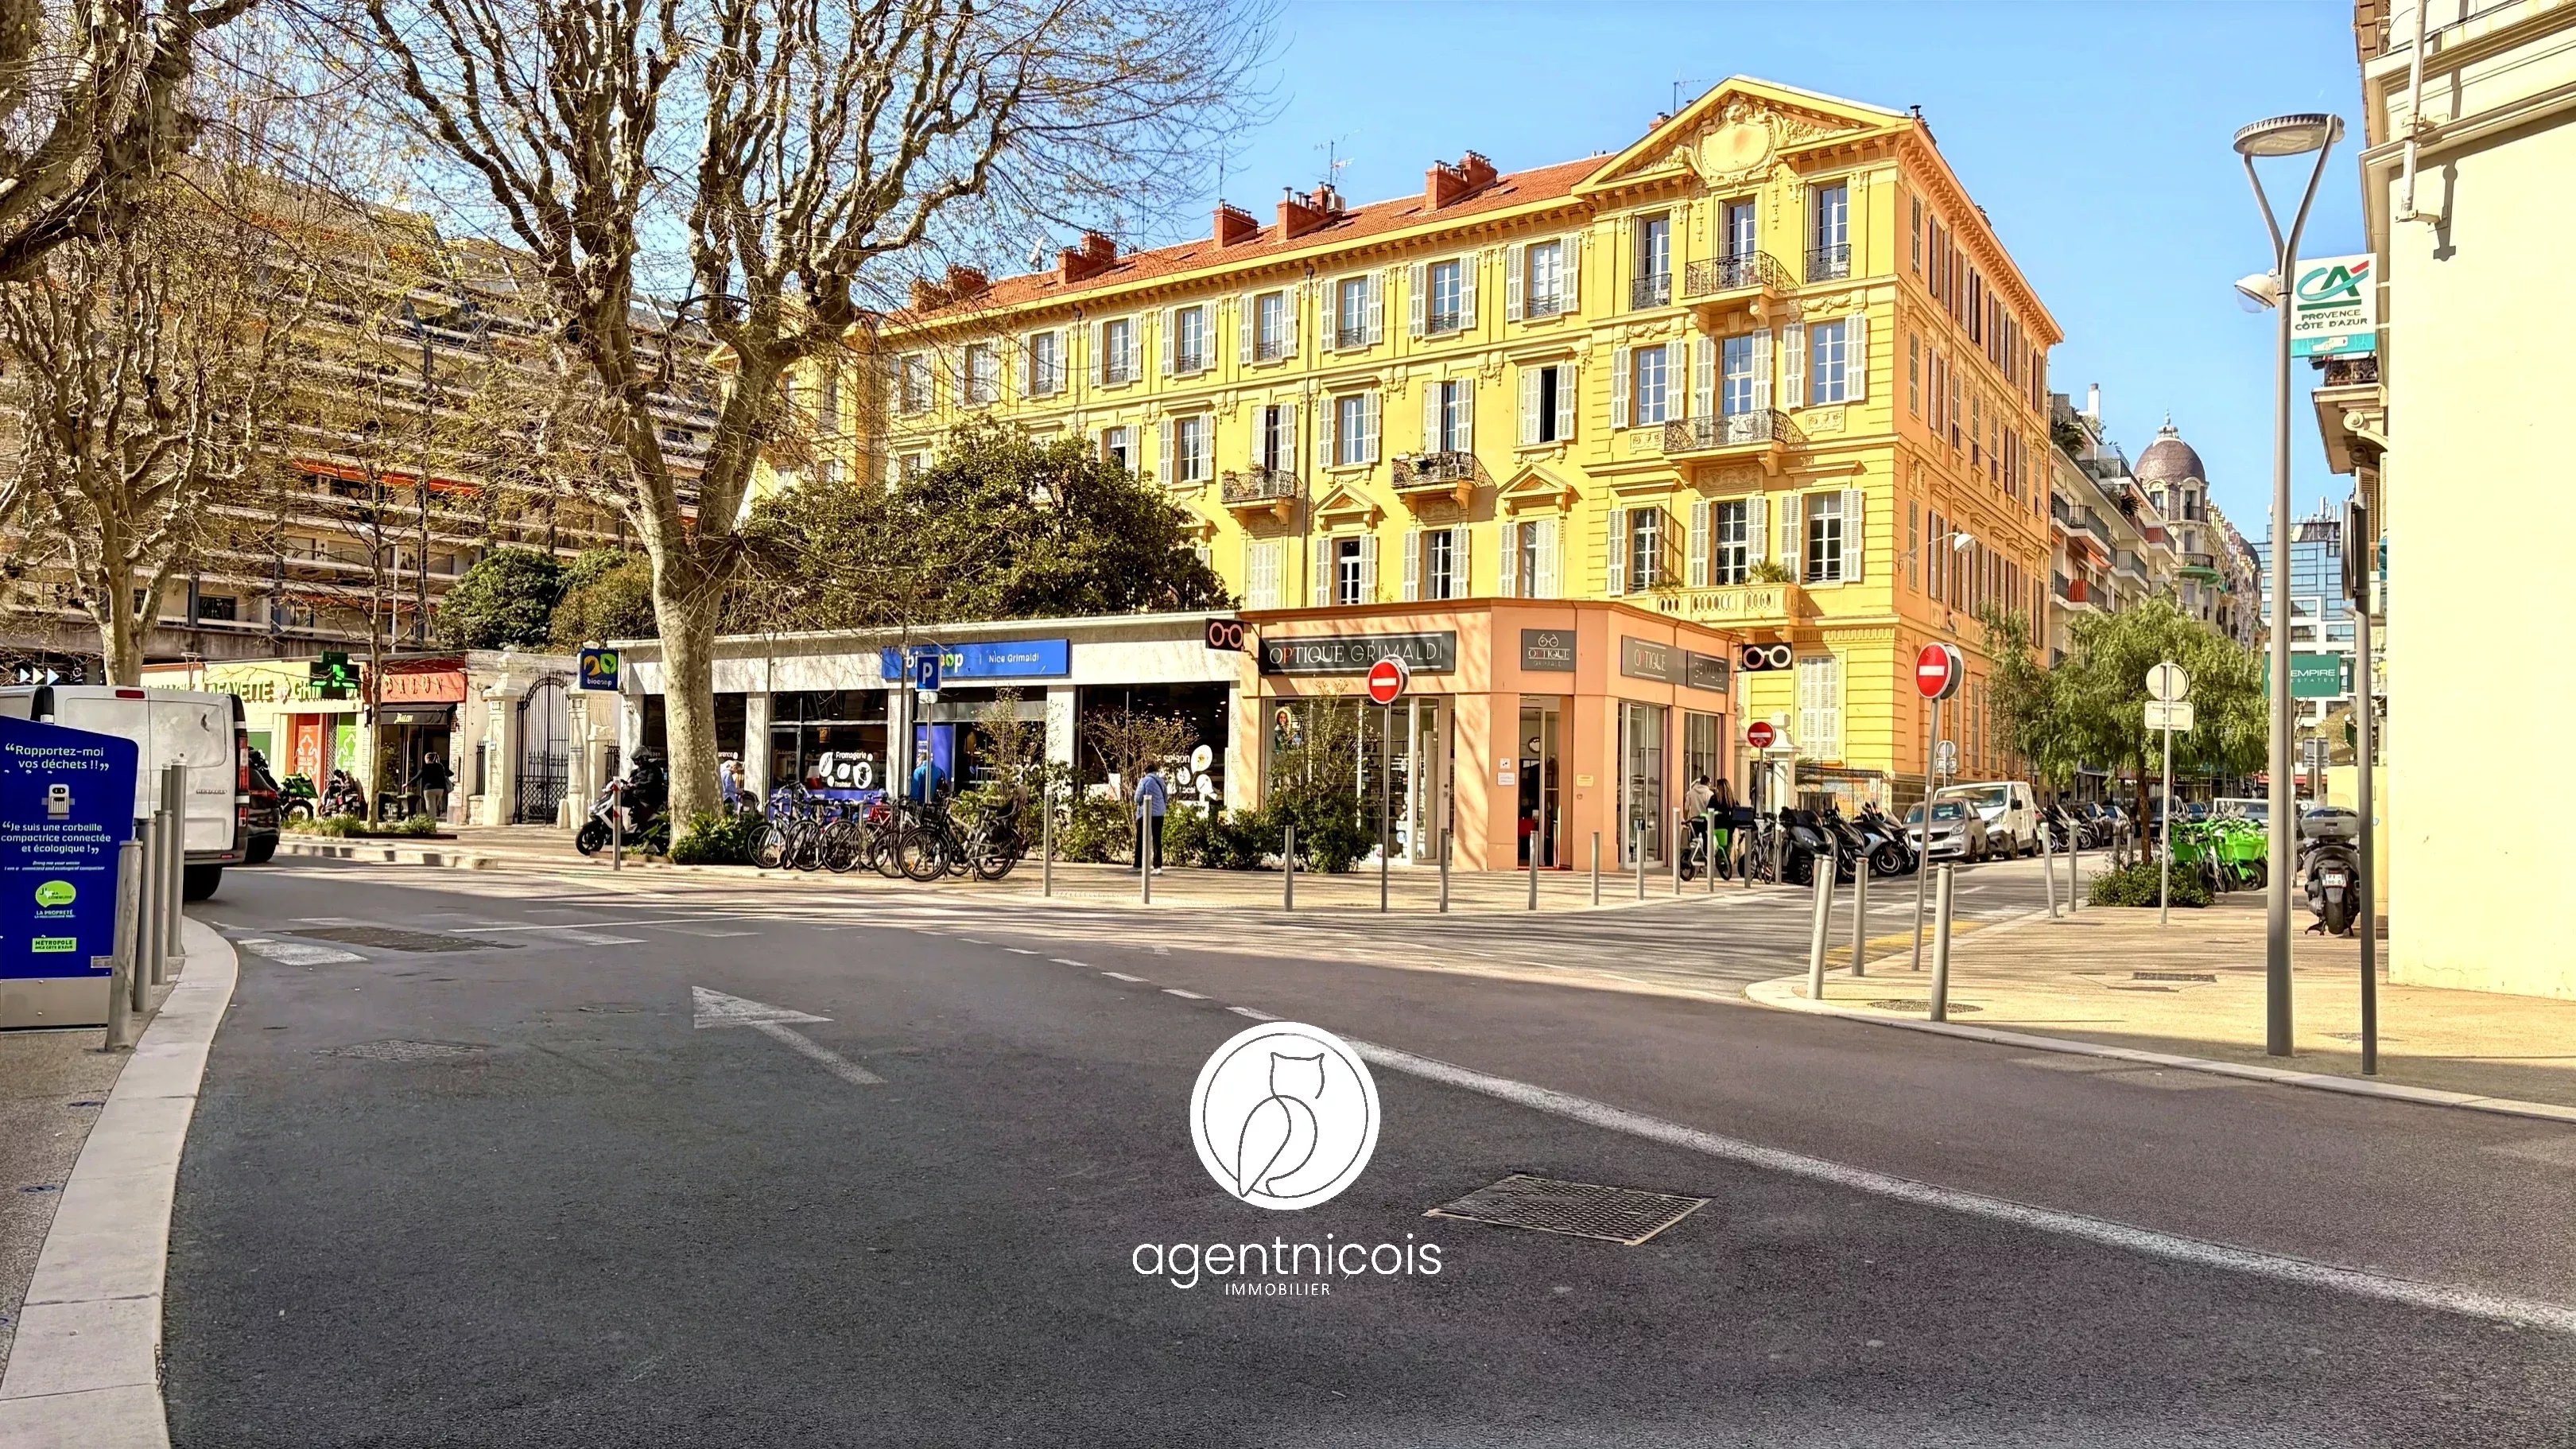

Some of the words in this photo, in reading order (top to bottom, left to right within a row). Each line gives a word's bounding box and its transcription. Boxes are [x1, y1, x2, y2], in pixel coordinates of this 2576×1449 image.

[2301, 309, 2361, 321] PROVENCE
[2295, 320, 2324, 331] CÔTE
[2329, 317, 2368, 328] D'AZUR
[1270, 645, 1345, 664] OPTIQUE
[1350, 640, 1442, 662] GRIMALDI
[1529, 649, 1569, 658] OPTIQUE
[988, 654, 1006, 663] Nice
[1007, 653, 1039, 662] Grimaldi
[1634, 648, 1666, 672] OPTIQUE
[922, 662, 933, 685] P
[836, 751, 867, 760] Fromagerie
[41, 759, 87, 769] déchets
[1, 834, 60, 843] compactrice
[62, 833, 111, 842] connectée
[33, 844, 85, 854] écologique
